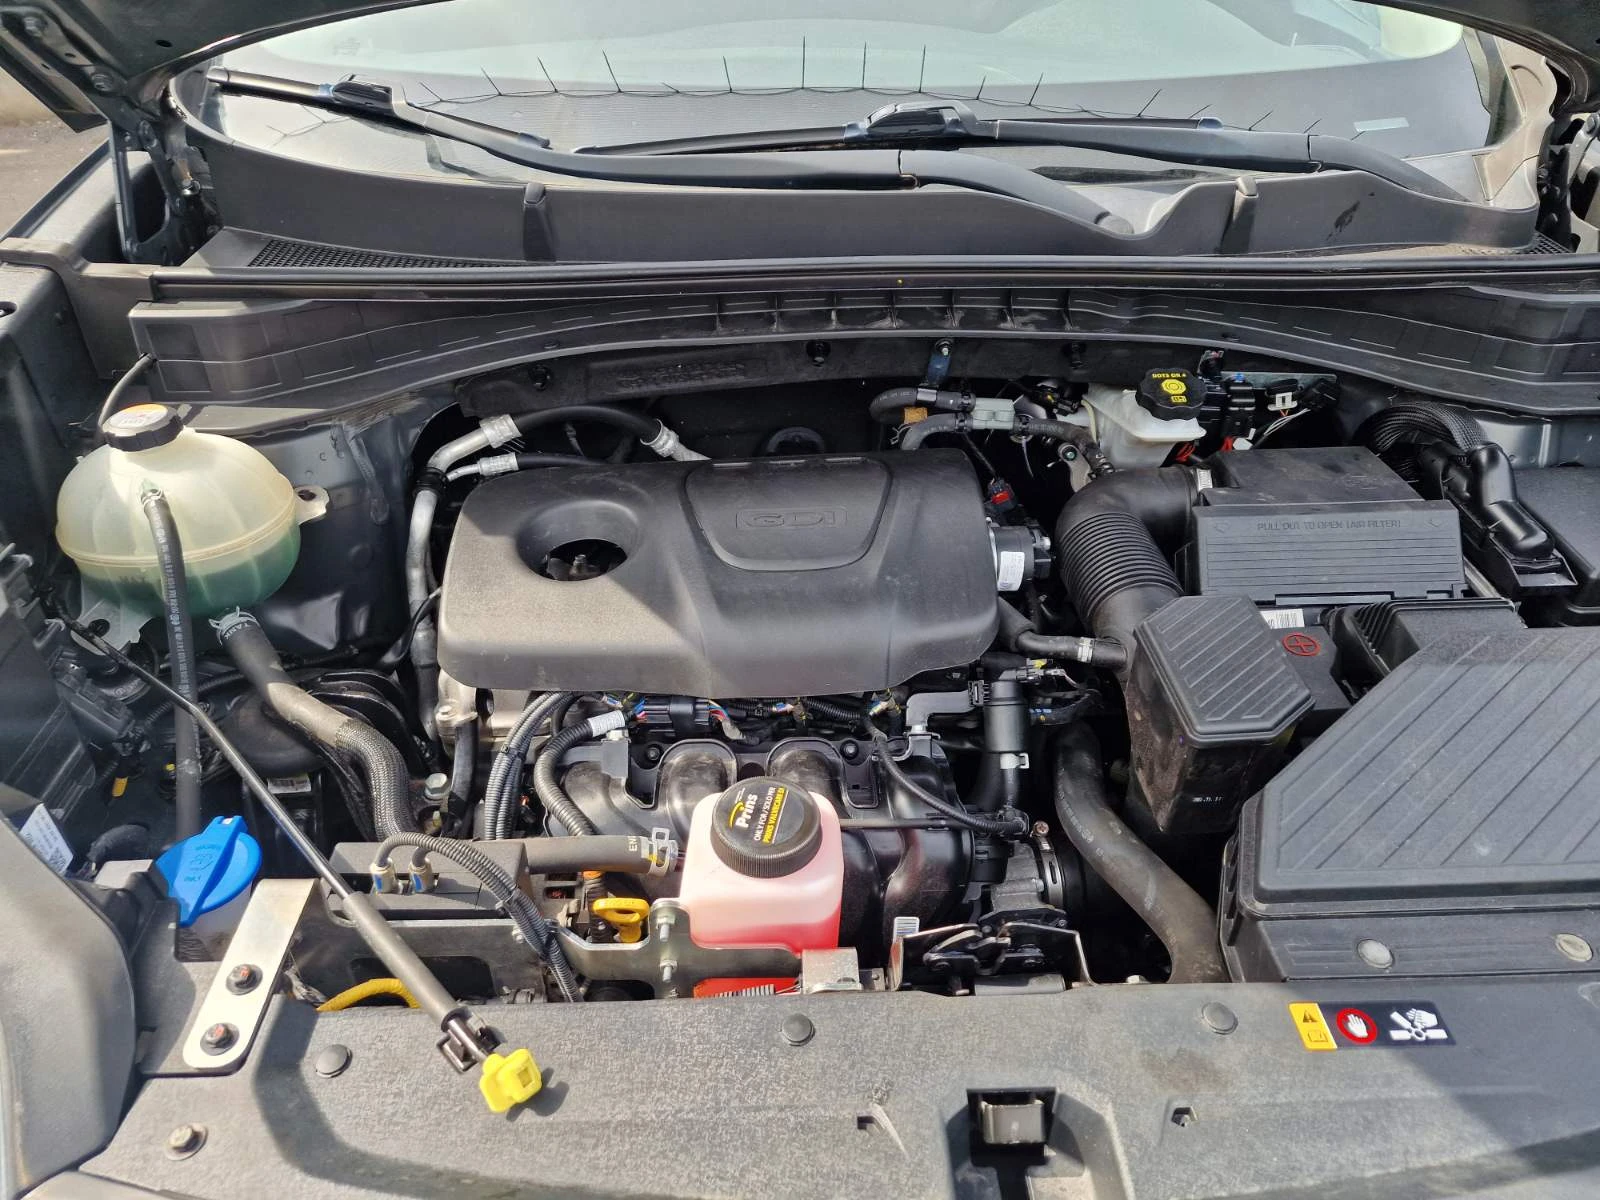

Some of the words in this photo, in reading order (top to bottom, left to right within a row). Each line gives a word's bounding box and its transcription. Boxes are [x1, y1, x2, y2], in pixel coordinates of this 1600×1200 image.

[743, 511, 835, 528] GDI
[1257, 521, 1281, 531] PULL
[1282, 520, 1300, 530] OUT
[1303, 520, 1315, 530] TO
[1317, 520, 1343, 530] OPEN
[735, 794, 758, 828] Prins
[762, 796, 773, 811] SOLO
[758, 813, 768, 825] FOR
[753, 824, 764, 841] ONLY
